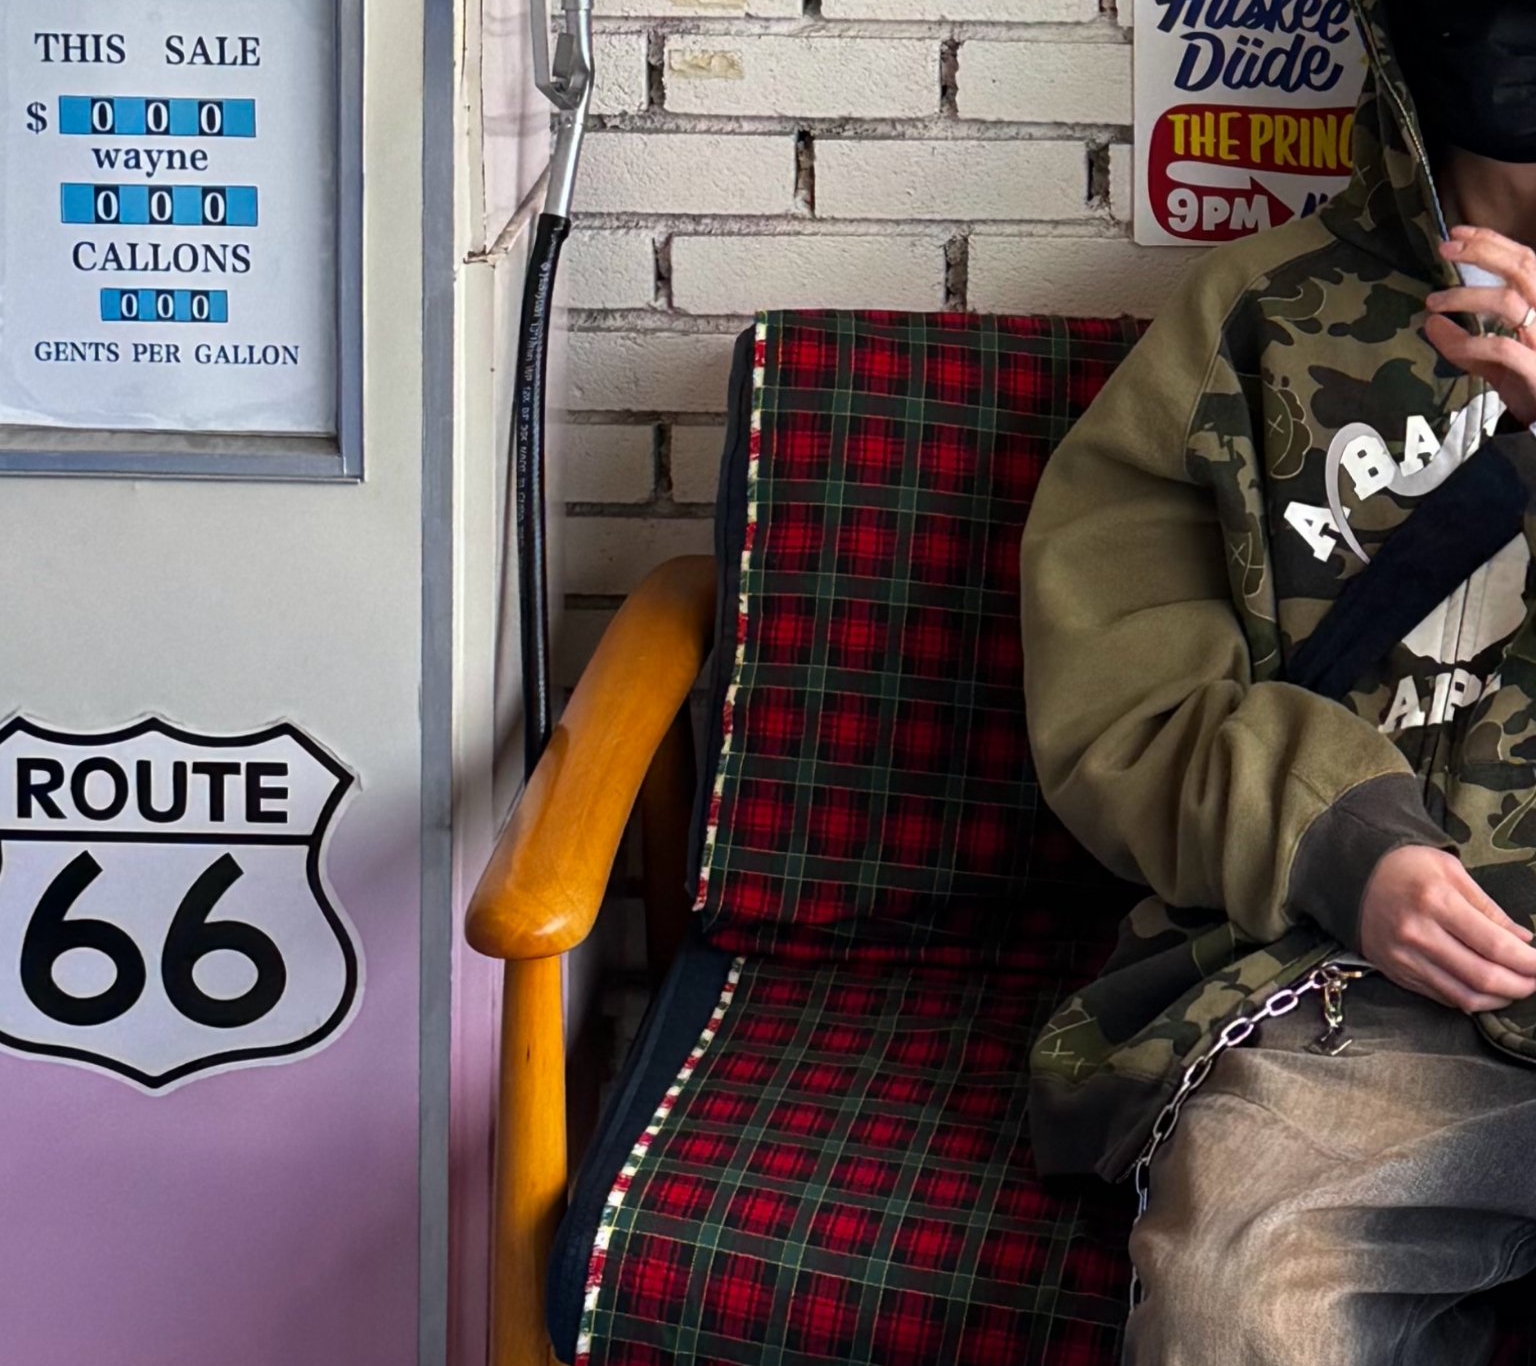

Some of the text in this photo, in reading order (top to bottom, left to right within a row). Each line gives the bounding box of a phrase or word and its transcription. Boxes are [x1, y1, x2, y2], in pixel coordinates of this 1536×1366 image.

[34, 33, 262, 67] THIS SALE
[1173, 32, 1345, 95] Düde
[26, 101, 49, 135] $
[1167, 112, 1242, 162] THE
[91, 145, 209, 177] wayne
[1166, 186, 1275, 234] 9PM
[72, 241, 253, 274] CALLONS
[131, 342, 183, 365] PER
[193, 343, 301, 367] GALLON
[1377, 666, 1502, 734] AP
[15, 755, 290, 824] ROUTE
[19, 849, 288, 1029] 66
